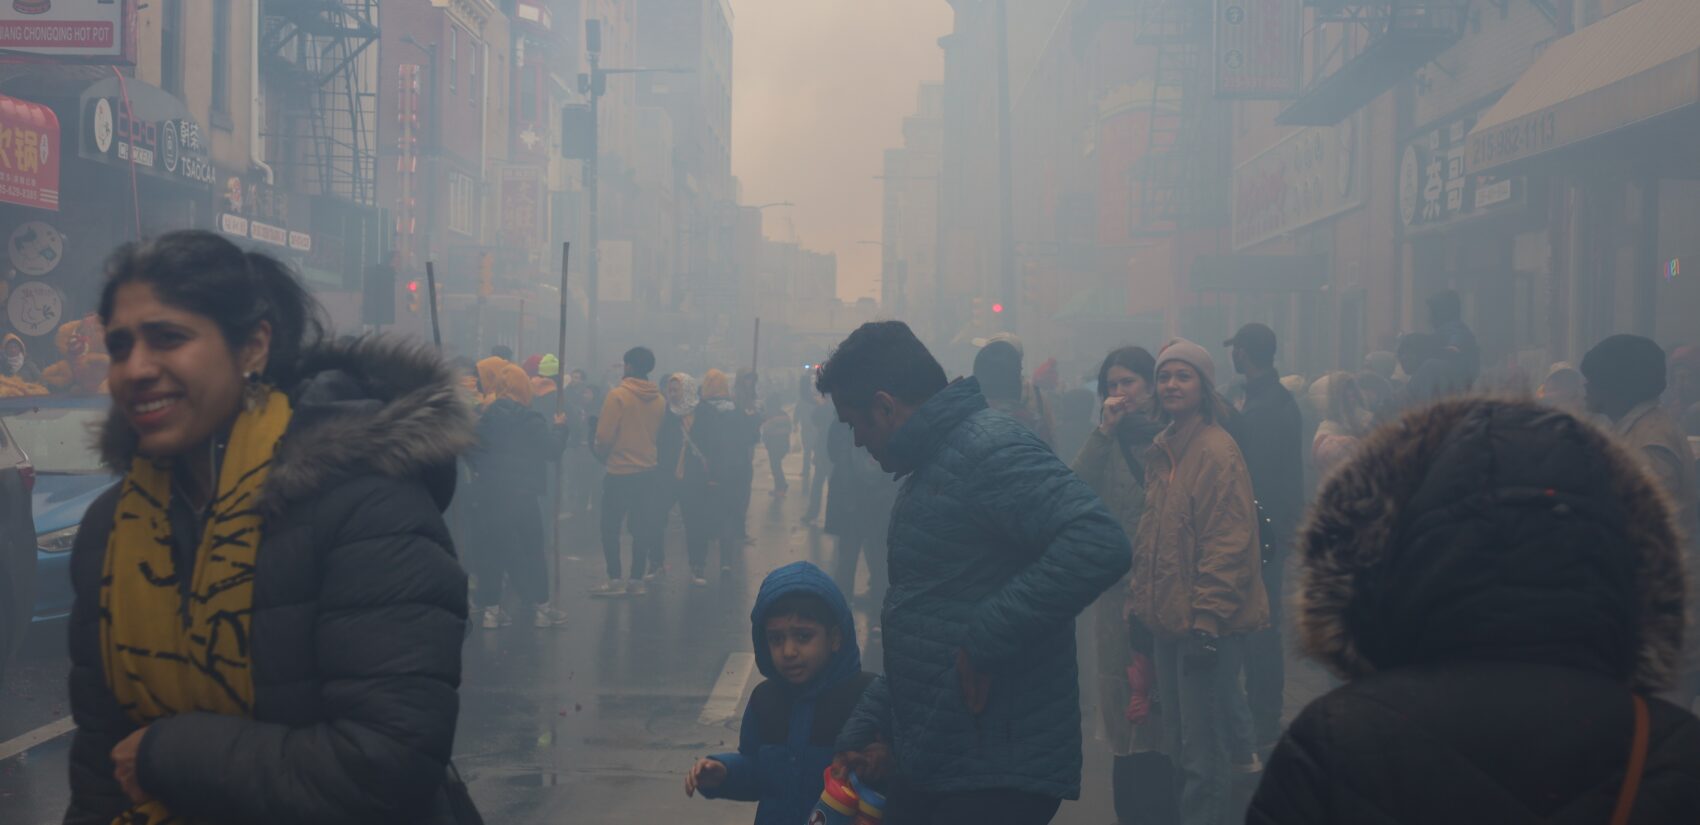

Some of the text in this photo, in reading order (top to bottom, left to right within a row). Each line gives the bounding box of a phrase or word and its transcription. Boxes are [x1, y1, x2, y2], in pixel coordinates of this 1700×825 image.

[23, 26, 73, 41] CHONGQING
[74, 27, 91, 41] HOT
[92, 27, 110, 41] POT
